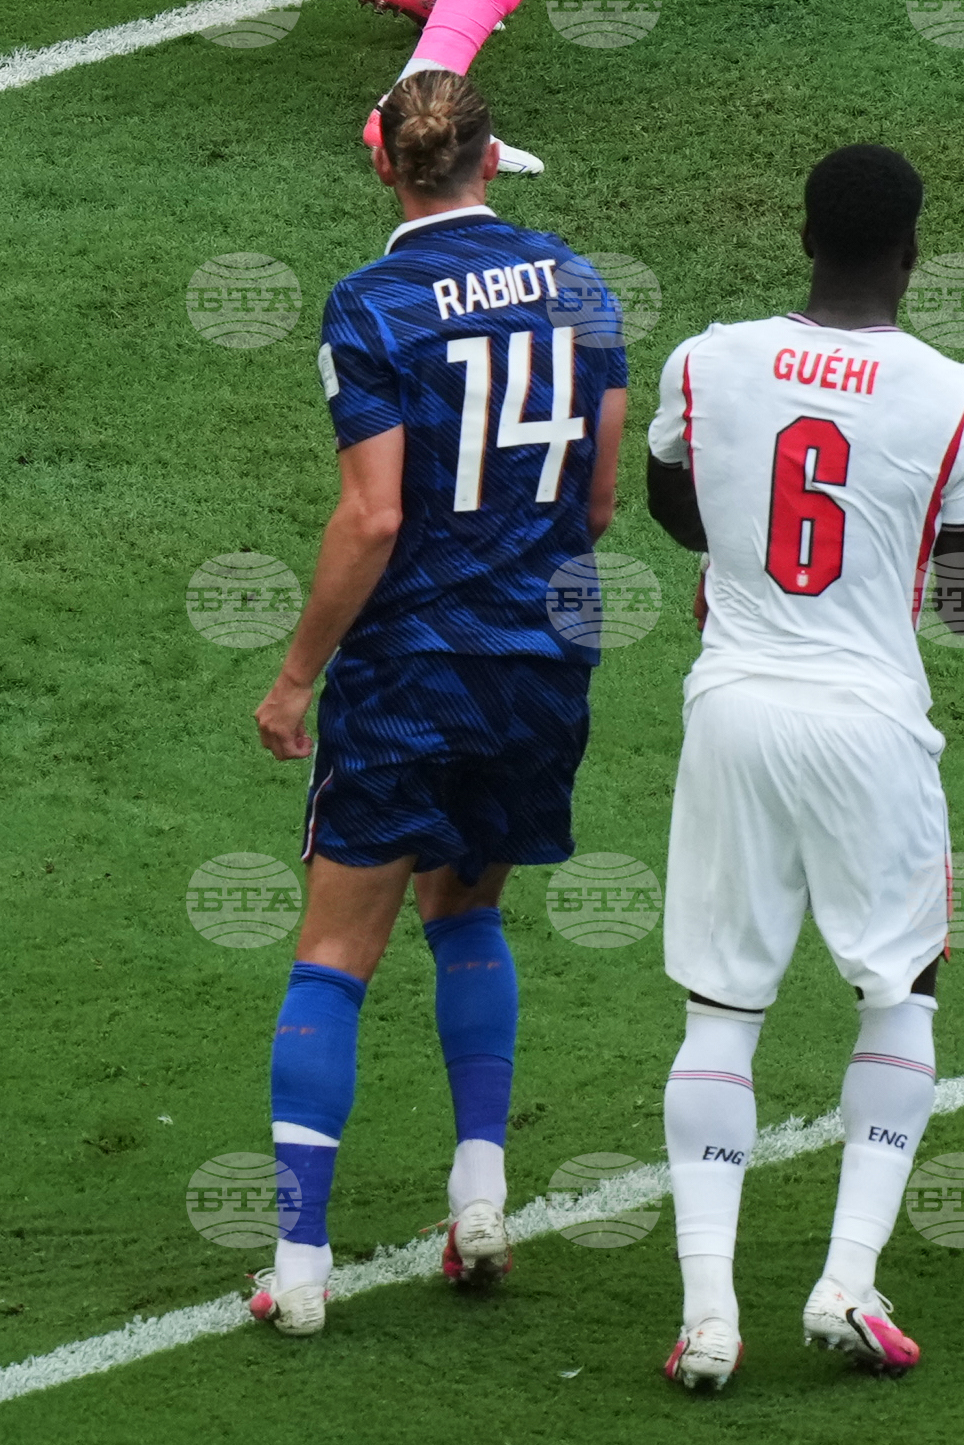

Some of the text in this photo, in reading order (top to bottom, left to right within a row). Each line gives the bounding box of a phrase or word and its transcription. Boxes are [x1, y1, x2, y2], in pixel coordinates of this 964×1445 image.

[433, 259, 558, 321] RABIOT
[773, 348, 880, 396] GUÉHI
[446, 327, 586, 513] 14
[765, 416, 851, 597] 6
[702, 1145, 745, 1166] ENG
[868, 1125, 908, 1150] ENG
